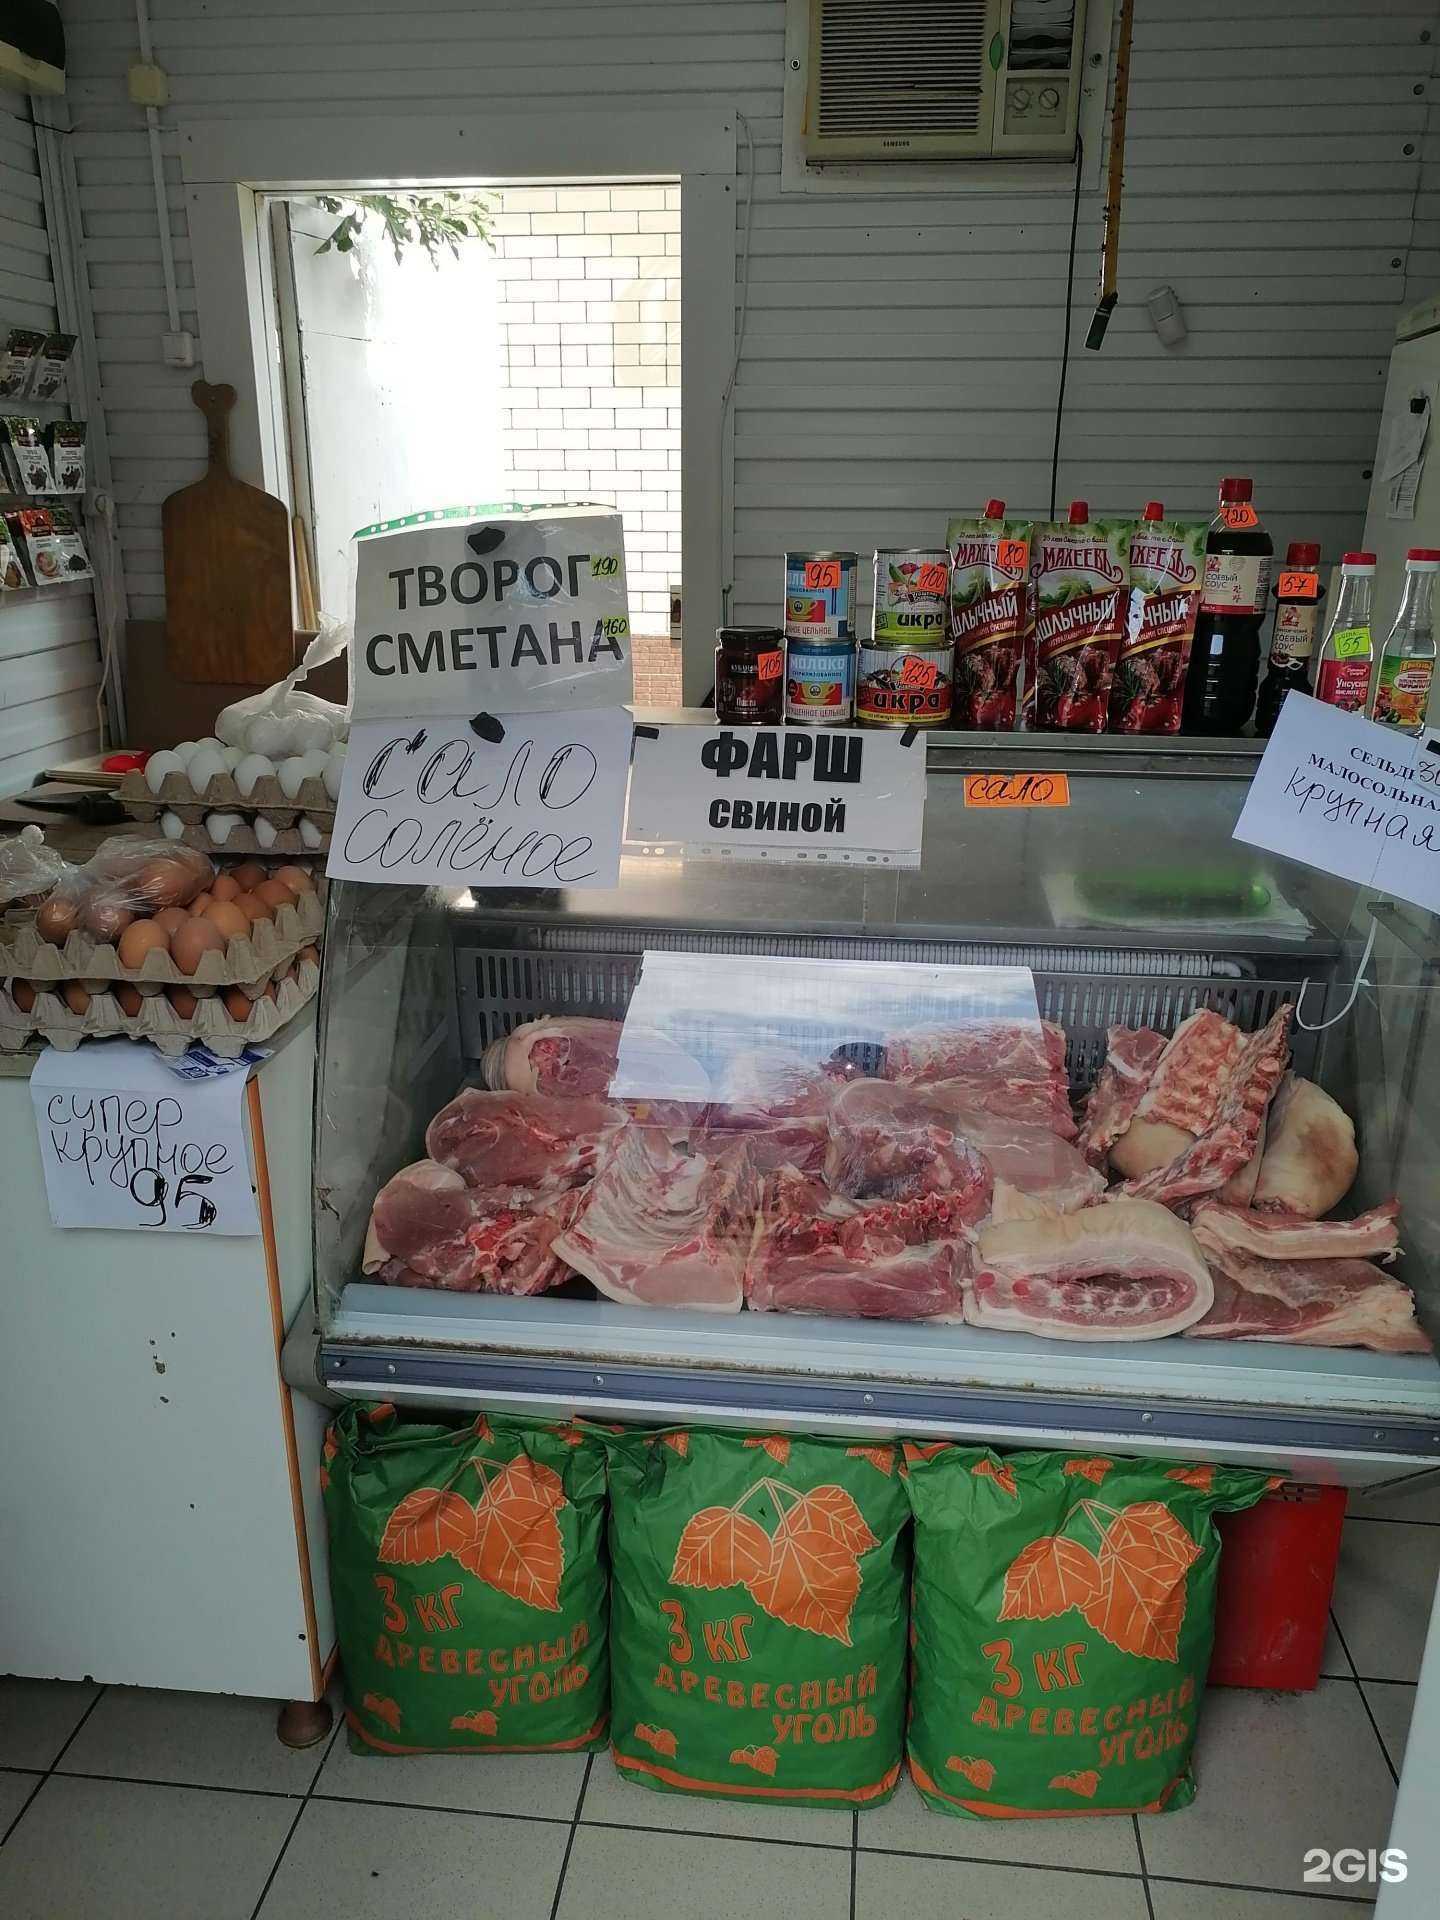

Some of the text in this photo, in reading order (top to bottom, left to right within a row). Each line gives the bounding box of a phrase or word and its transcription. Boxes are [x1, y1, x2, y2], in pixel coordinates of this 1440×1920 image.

[592, 556, 618, 576] 190
[810, 563, 838, 588] 95
[921, 566, 946, 589] 100
[1004, 544, 1024, 564] 80
[388, 554, 591, 610] ТВОРОГ
[1284, 577, 1307, 593] 57
[603, 618, 627, 636] 160
[952, 591, 1019, 639] ШЛЫЧНЫЙ
[366, 617, 625, 676] СМЕТАНА
[700, 731, 863, 783] ФАРШ
[1308, 753, 1440, 812] МАЛОСОЛЬНА
[708, 797, 846, 833] СВИНОЙ
[130, 1167, 217, 1229] 95
[374, 1574, 409, 1634] 3
[660, 1600, 694, 1663] 3
[655, 1663, 879, 1710] ДРЕВЕСНЫЙ
[980, 1638, 1023, 1697] 3
[772, 1703, 878, 1745] УГОЛЬ
